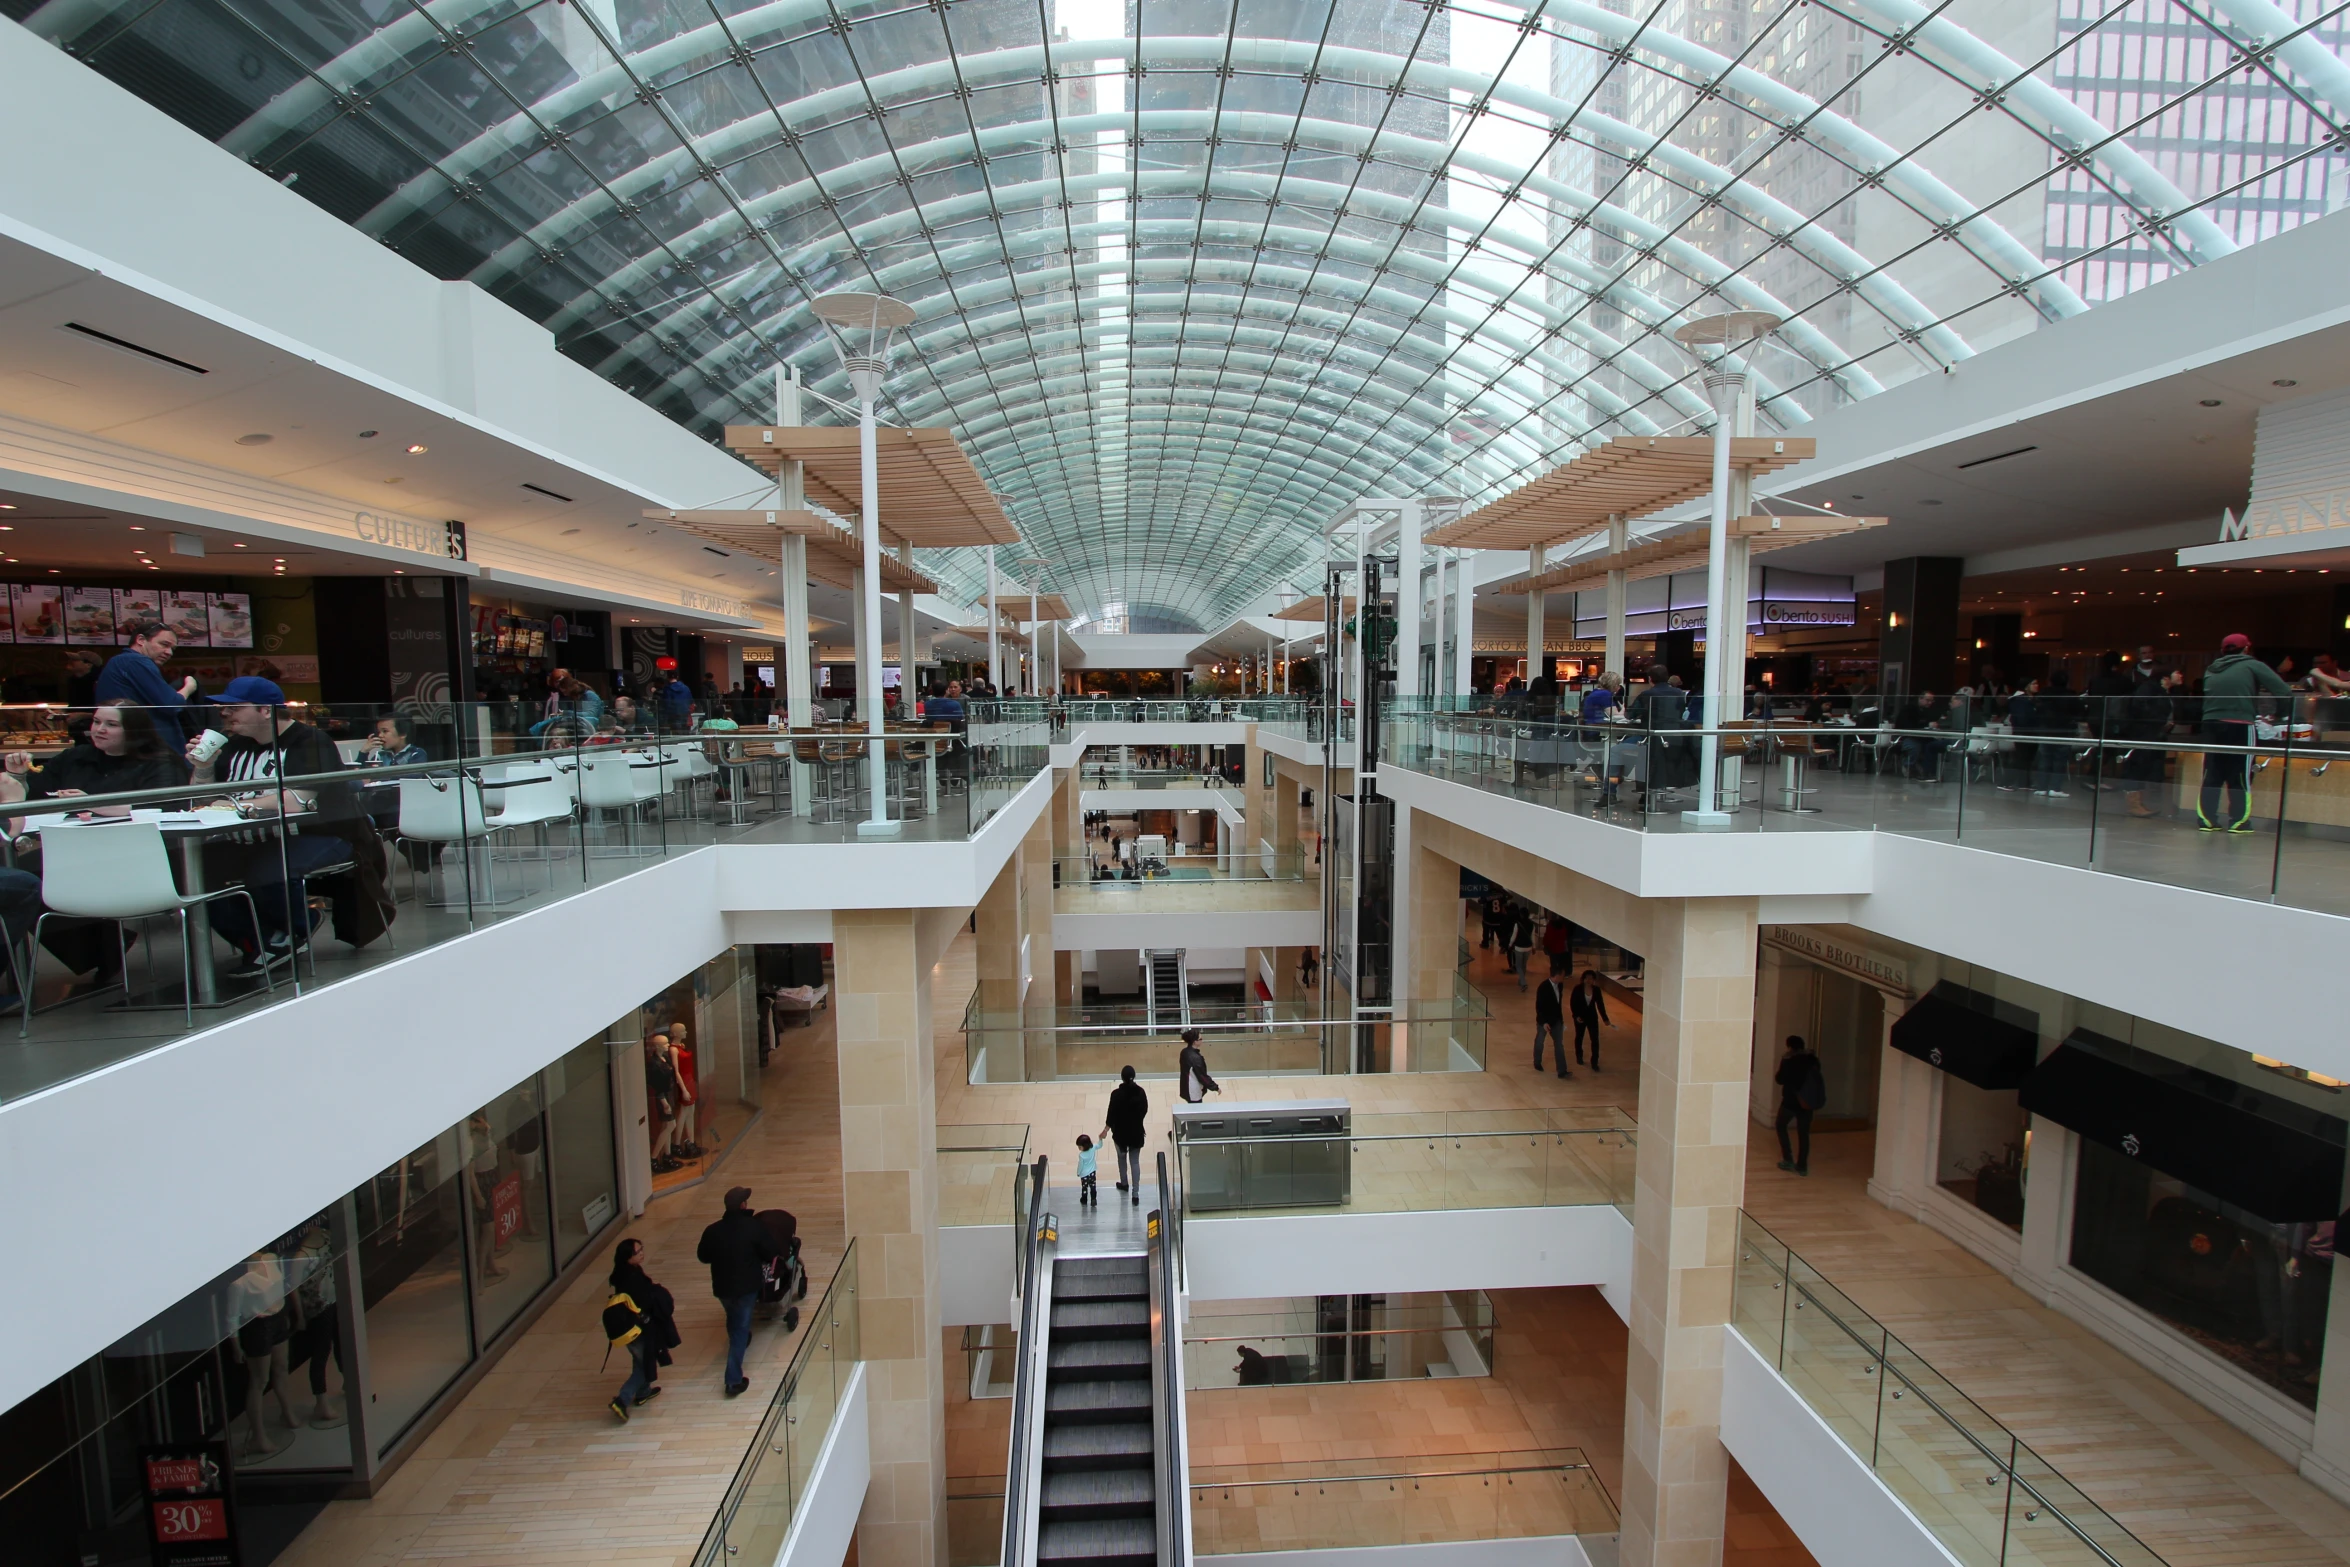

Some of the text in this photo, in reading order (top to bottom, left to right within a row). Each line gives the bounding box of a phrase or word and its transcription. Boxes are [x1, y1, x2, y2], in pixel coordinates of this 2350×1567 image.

[355, 511, 464, 560] CULTURES
[681, 589, 697, 608] RIPE
[699, 594, 731, 614] TOMATO
[1782, 608, 1854, 624] bento SUSHI
[389, 628, 442, 640] cultures
[1472, 640, 1511, 651] KORYO
[1569, 641, 1592, 651] BBQ
[1774, 926, 1903, 985] BROOKS BROTHERS
[152, 1465, 198, 1476] FRIENDS
[163, 1474, 198, 1483] FAMILY
